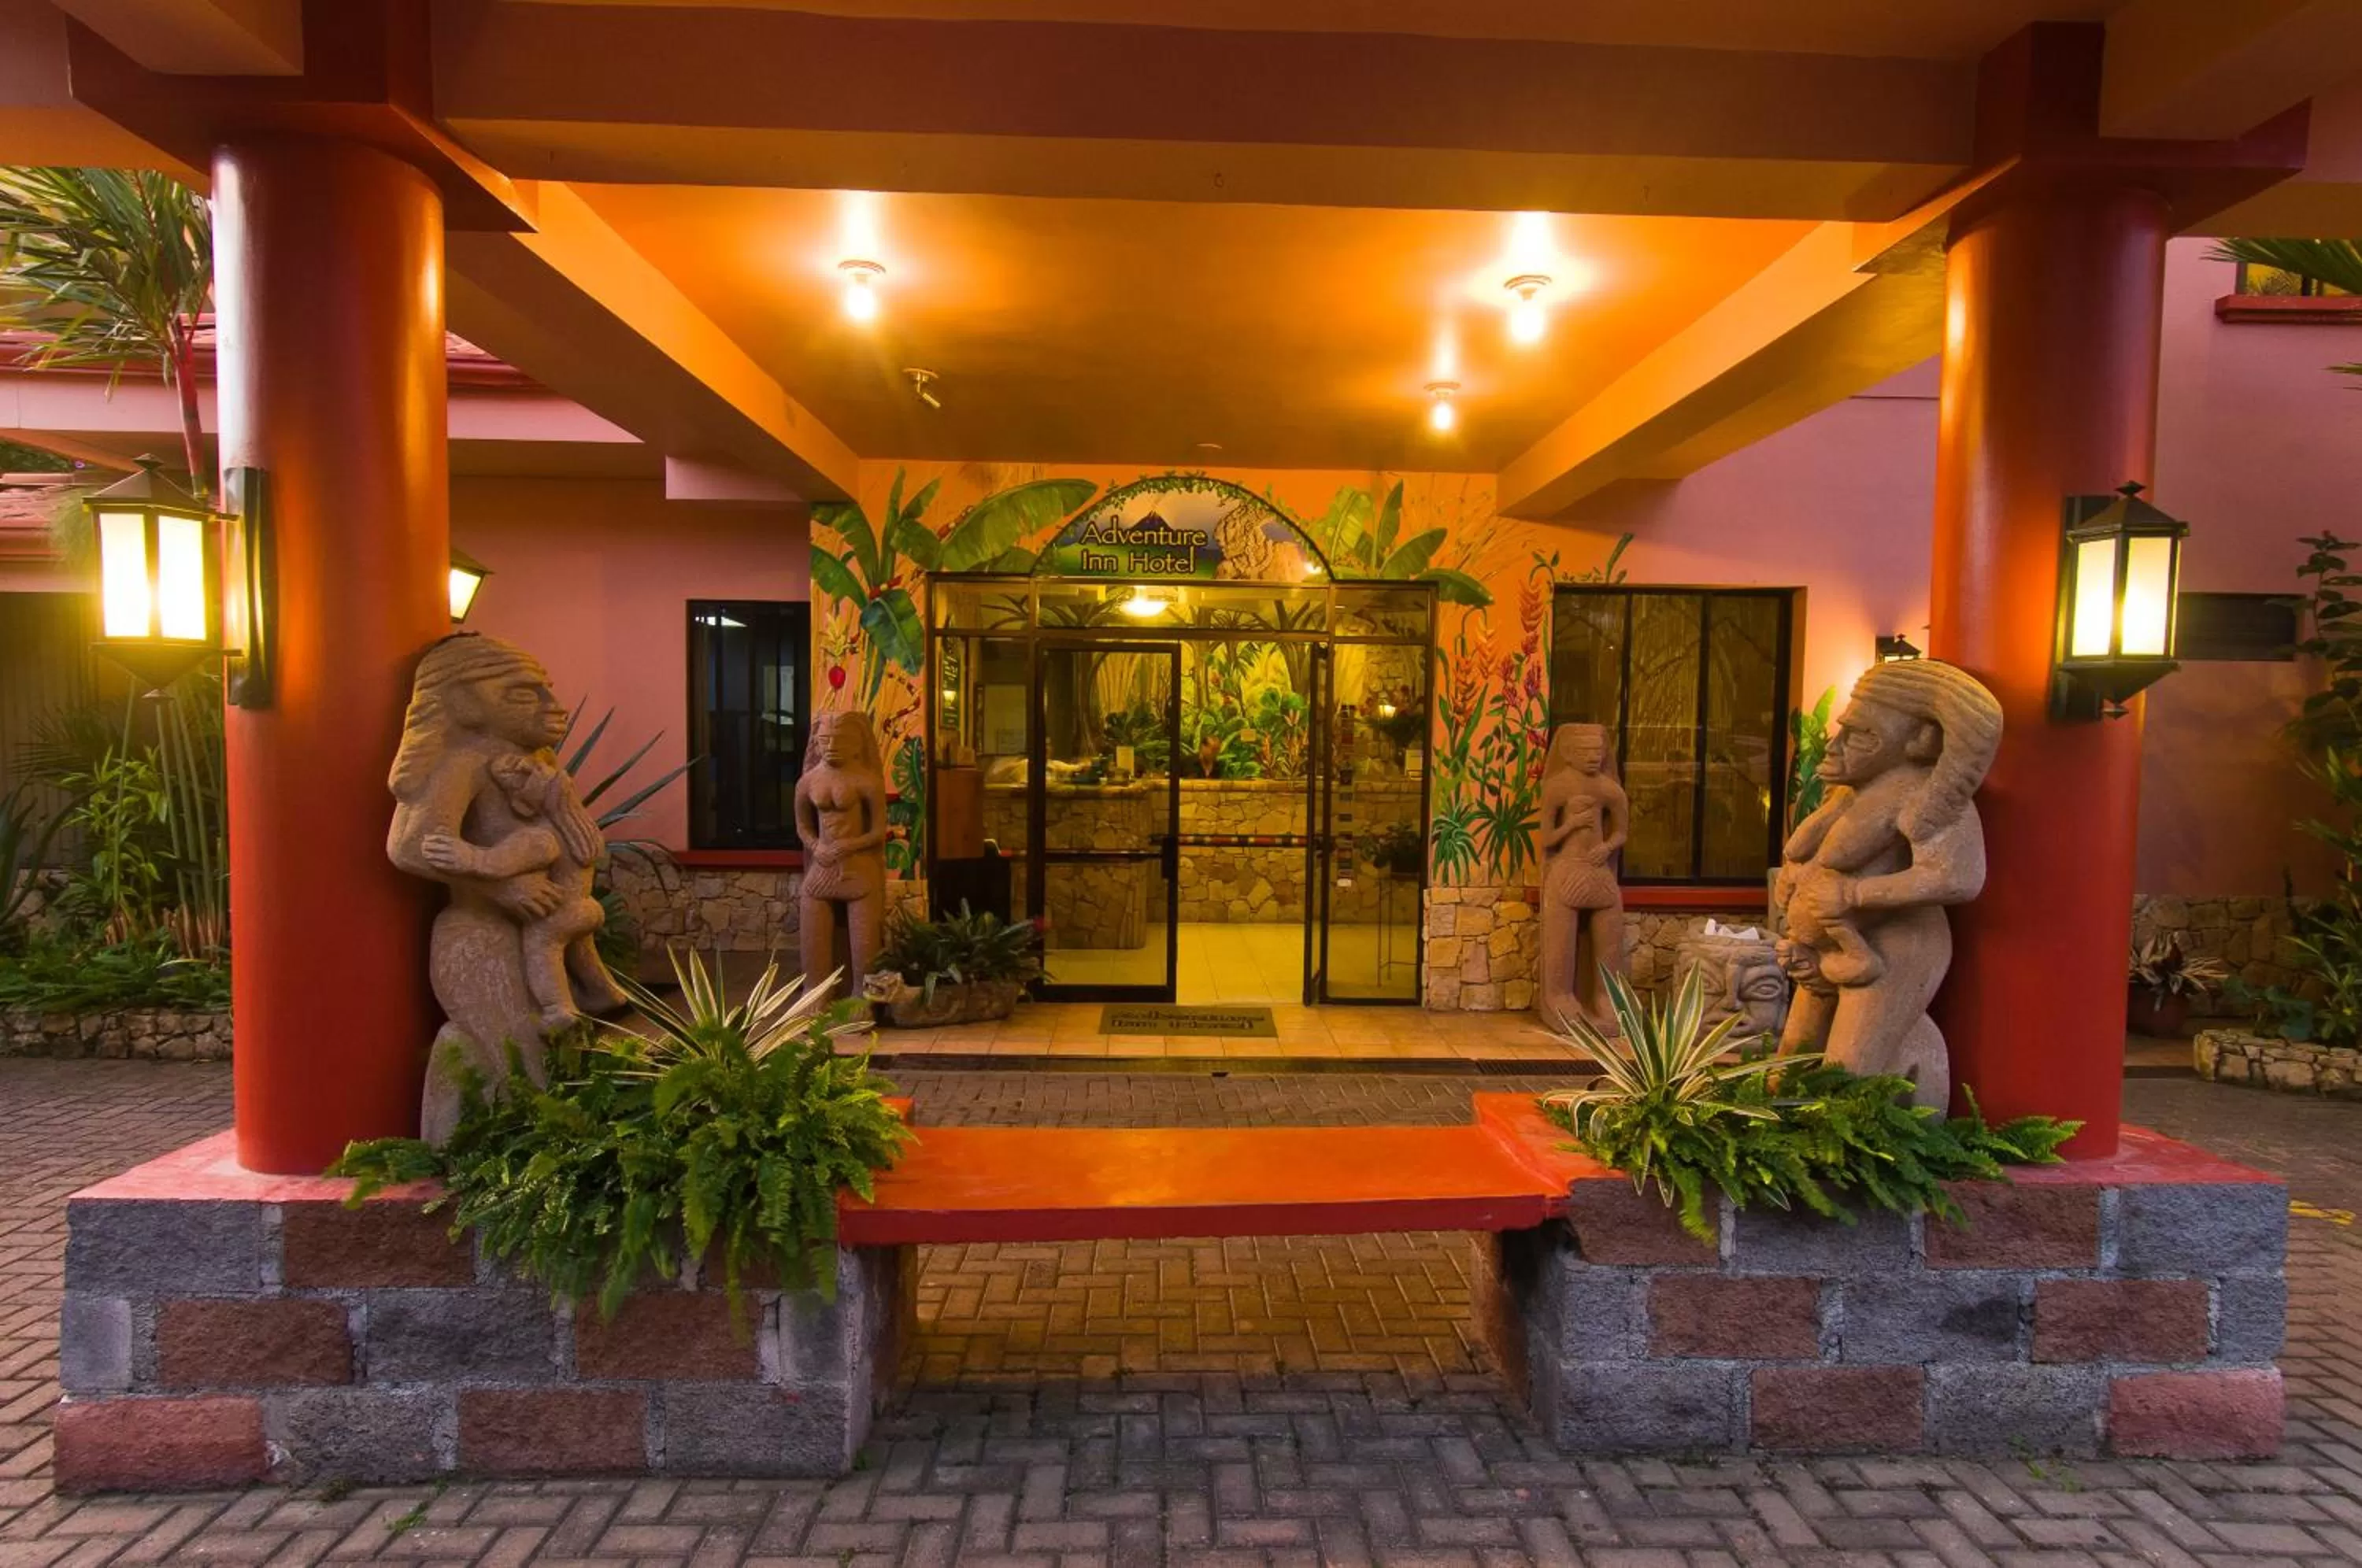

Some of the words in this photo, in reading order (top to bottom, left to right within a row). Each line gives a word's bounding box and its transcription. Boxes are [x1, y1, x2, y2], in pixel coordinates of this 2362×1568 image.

[1081, 516, 1208, 547] Adventure
[1083, 549, 1118, 571] Inn
[1128, 548, 1195, 573] Hotel
